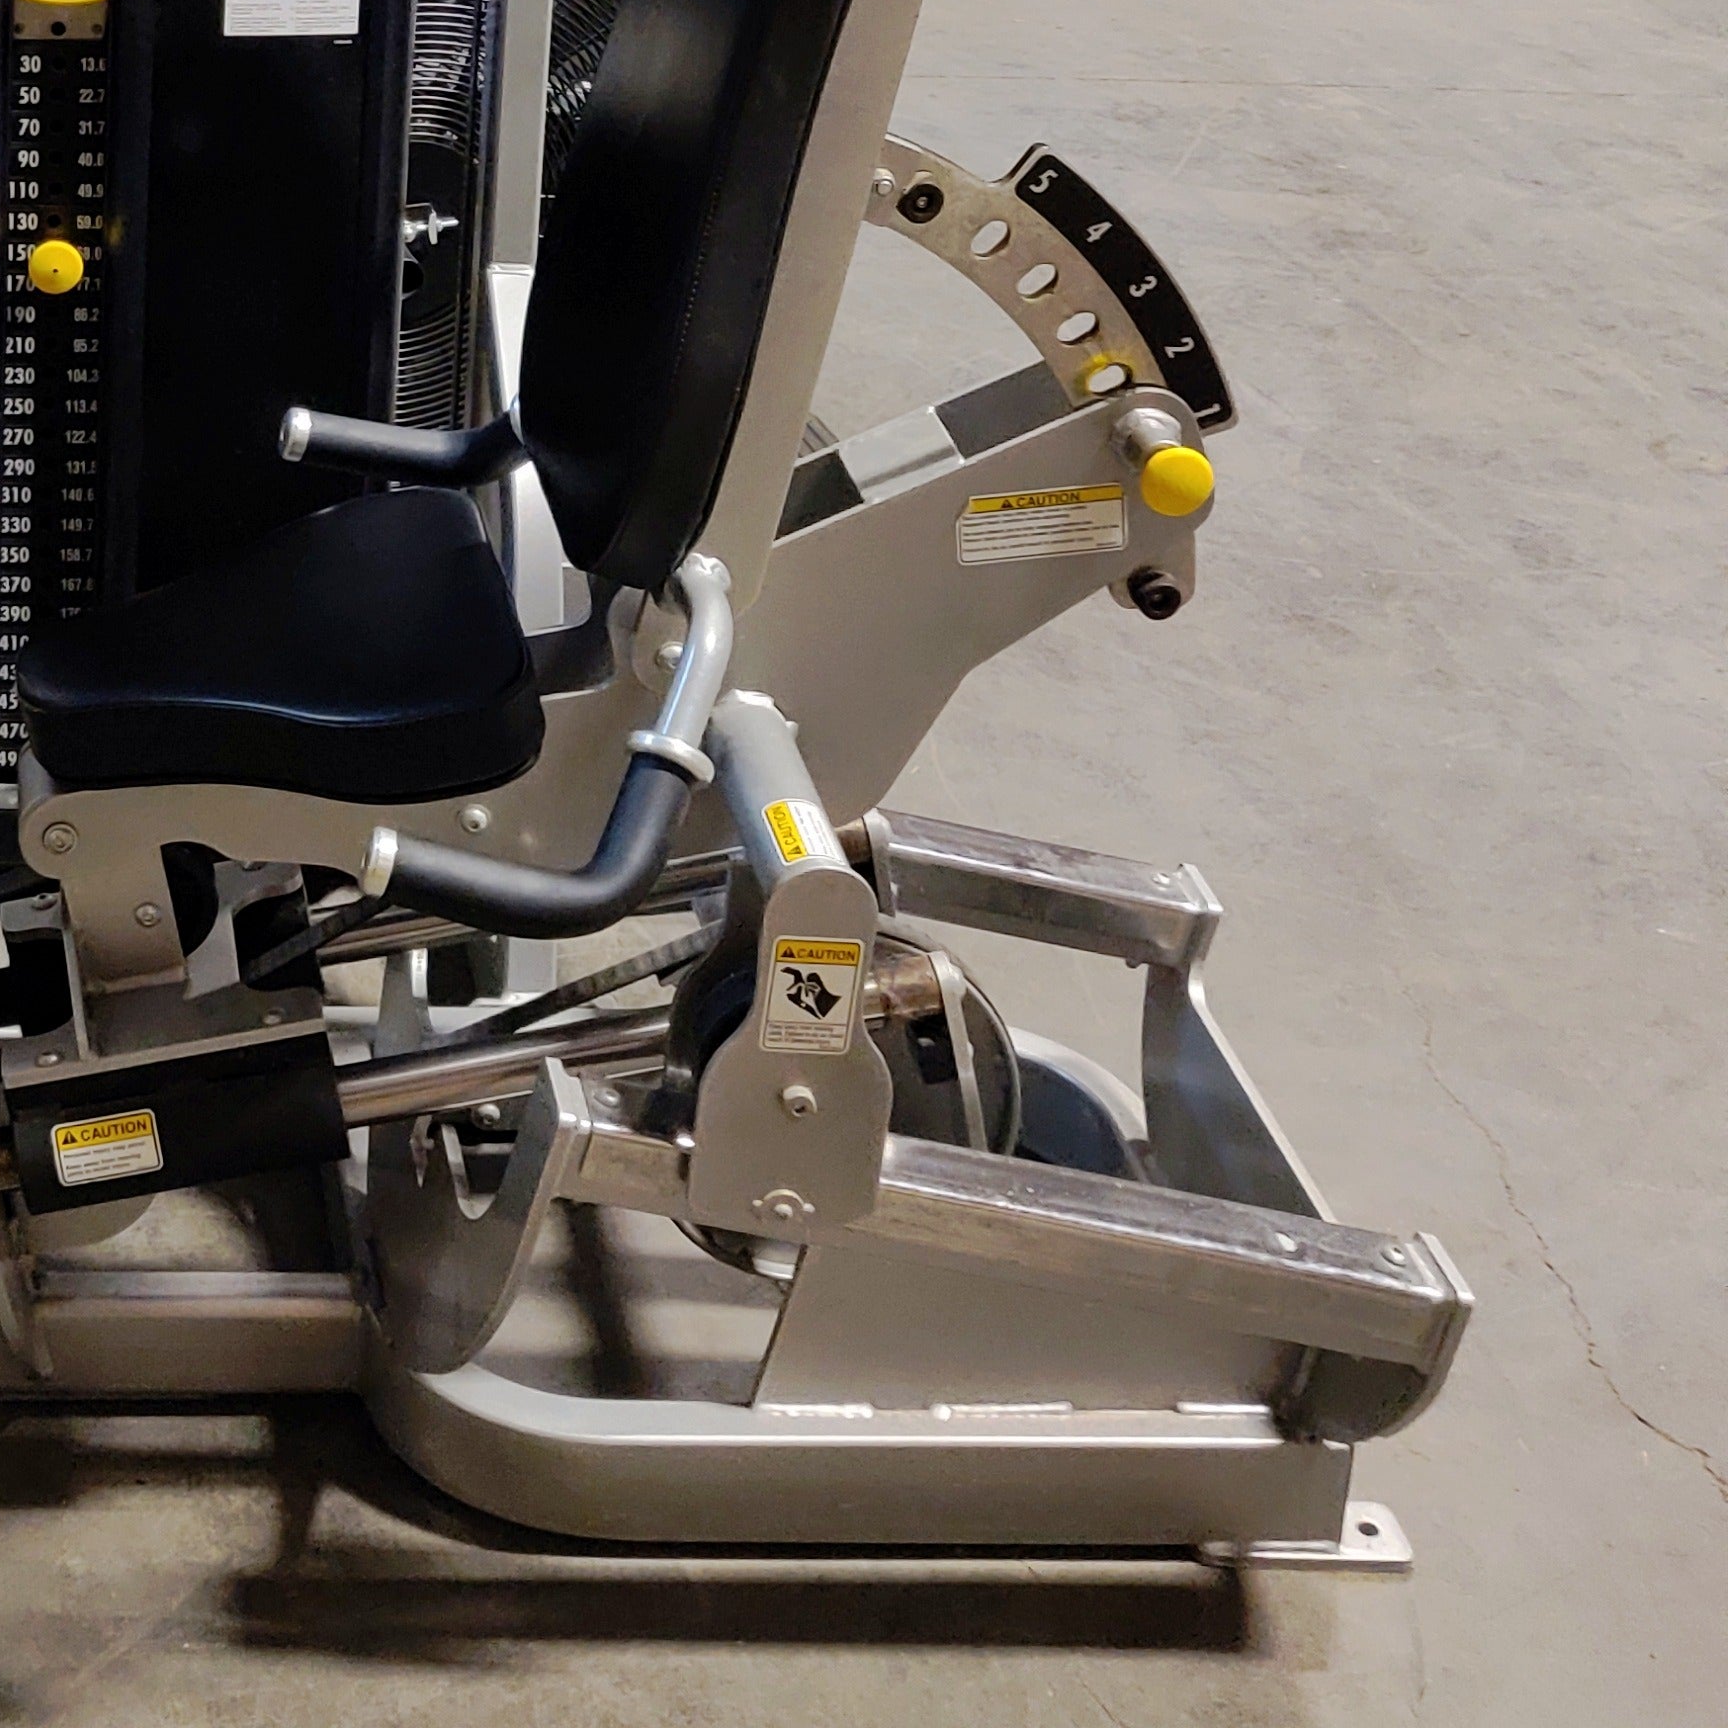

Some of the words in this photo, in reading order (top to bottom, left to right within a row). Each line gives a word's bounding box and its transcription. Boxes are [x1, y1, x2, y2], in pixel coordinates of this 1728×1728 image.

[19, 55, 42, 73] 30
[18, 86, 41, 104] 50
[79, 88, 105, 103] 22.7
[18, 118, 40, 136] 70
[78, 120, 105, 135] 31.7
[18, 150, 40, 168] 90
[1029, 169, 1059, 193] 5
[9, 181, 39, 199] 110
[8, 213, 38, 230] 130
[1086, 221, 1113, 243] 4
[1129, 275, 1158, 297] 3
[6, 306, 36, 323] 190
[5, 337, 35, 354] 210
[1164, 336, 1195, 359] 2
[4, 367, 35, 384] 230
[3, 397, 35, 415] 250
[65, 399, 98, 413] 113.4
[3, 428, 34, 445] 270
[65, 430, 97, 444] 122.4
[3, 458, 35, 476] 290
[1, 486, 32, 503] 310
[61, 488, 94, 502] 140.6
[1016, 492, 1080, 508] CAUTION
[1, 516, 31, 533] 330
[61, 518, 93, 531] 149.7
[0, 546, 30, 563] 350
[0, 576, 31, 593] 370
[772, 806, 797, 846] CAUTION
[797, 948, 856, 961] CAUTION
[80, 1119, 148, 1142] CAUTION
